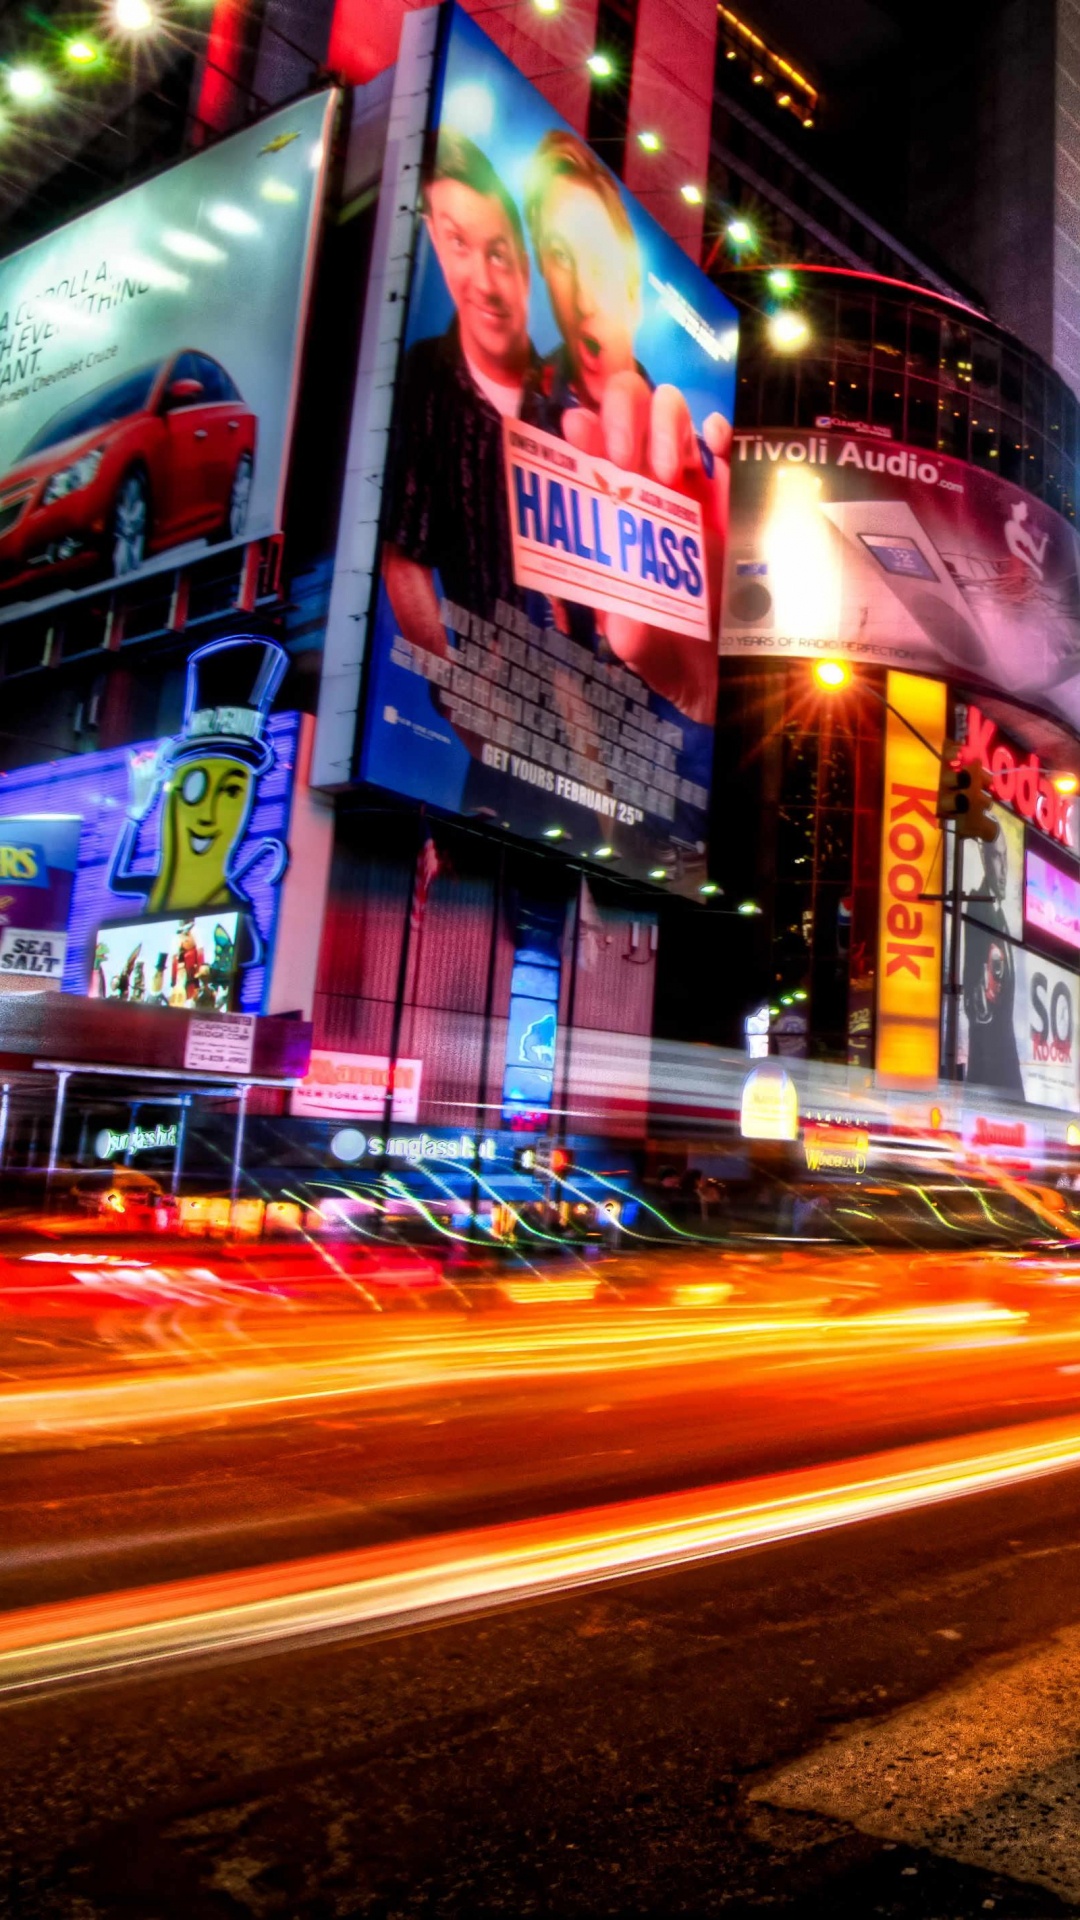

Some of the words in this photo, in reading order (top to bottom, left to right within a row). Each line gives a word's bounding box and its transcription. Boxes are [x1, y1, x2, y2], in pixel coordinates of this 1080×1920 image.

[735, 435, 828, 464] Tivoli
[512, 464, 611, 567] HALL
[618, 509, 702, 598] PASS
[738, 637, 774, 646] YEARS
[778, 638, 795, 647] OF
[799, 638, 838, 650] RADIO
[482, 743, 509, 772] GET
[511, 755, 556, 792] YOURS
[556, 774, 617, 818] FEBRUARY
[886, 782, 939, 981] Kodak
[12, 938, 52, 957] SEA
[1, 953, 61, 973] SALT
